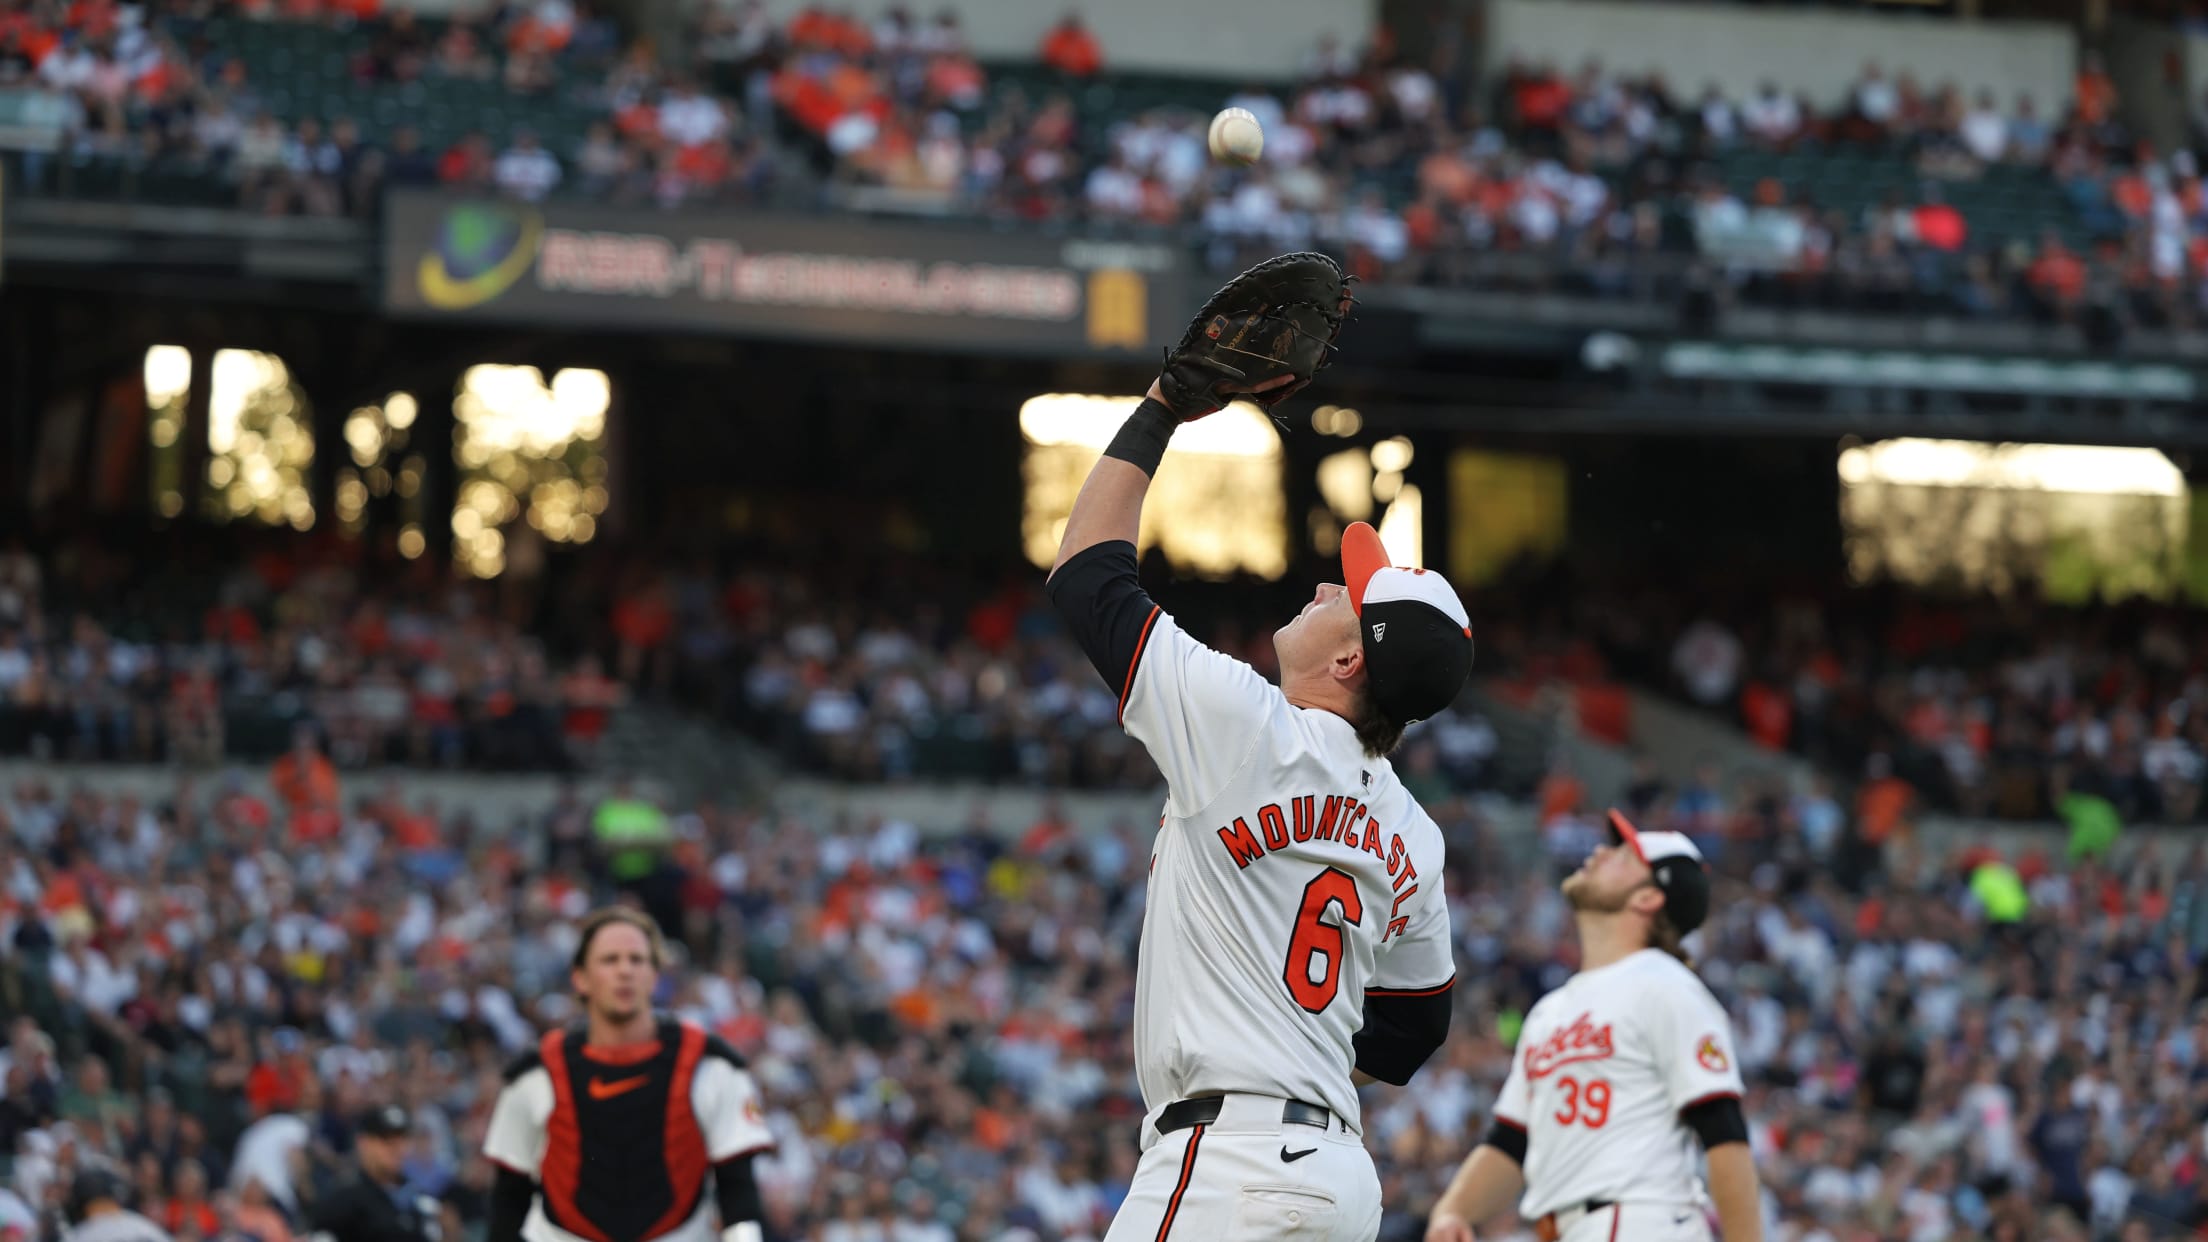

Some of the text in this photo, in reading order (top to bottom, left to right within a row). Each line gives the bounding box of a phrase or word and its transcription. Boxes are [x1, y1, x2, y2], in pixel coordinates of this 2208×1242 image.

[1217, 795, 1418, 943] MOUNTCASTLE
[1283, 866, 1363, 1015] 6
[1555, 1076, 1611, 1129] 39
